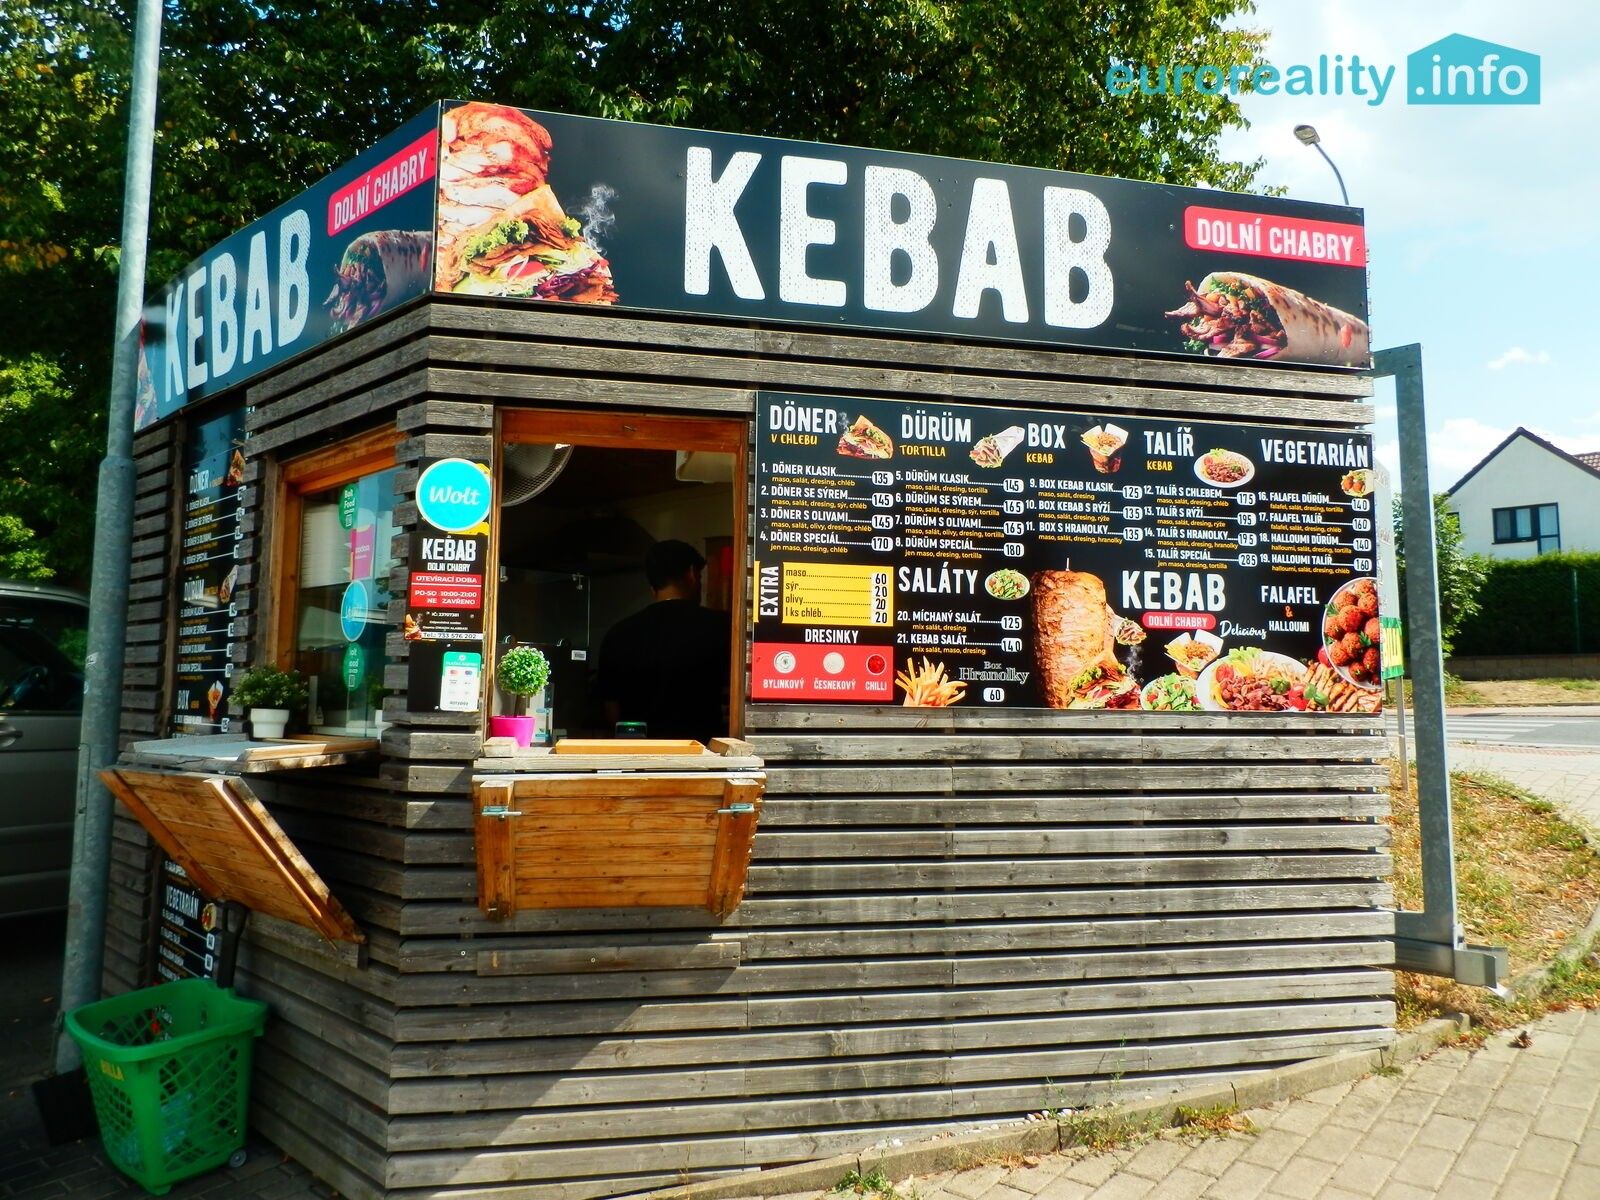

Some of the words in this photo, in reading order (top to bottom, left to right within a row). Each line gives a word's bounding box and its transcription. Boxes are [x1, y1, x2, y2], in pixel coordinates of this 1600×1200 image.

[333, 175, 370, 231] DOLNÍ
[373, 147, 428, 206] CHABRY
[684, 146, 1114, 329] KEBAB
[1196, 217, 1262, 253] DOLNÍ
[1268, 226, 1355, 262] CHABRY
[165, 209, 311, 403] KEBAB
[770, 400, 837, 434] DÖNER
[901, 410, 971, 443] DÜRÜM
[771, 433, 778, 443] V
[780, 434, 818, 445] CHLEBU
[1027, 423, 1066, 449] BOX
[1143, 426, 1194, 457] TALÍŘ
[899, 445, 946, 457] TORTILLA
[1026, 453, 1054, 464] KEBAB
[1260, 438, 1368, 467] VEGETARIÁN
[772, 461, 803, 474] DÖNER
[805, 466, 837, 477] KLASIK
[874, 472, 888, 484] 135
[1146, 460, 1173, 471] KEBAB
[905, 469, 937, 482] DÜRÜM
[939, 473, 969, 484] KLASIK
[1004, 479, 1019, 491] 145
[1038, 479, 1056, 490] BOX
[1057, 480, 1083, 491] KEBAB
[1085, 482, 1114, 493] KLASIK
[1124, 486, 1139, 498] 125
[429, 486, 481, 505] Wolt
[771, 484, 801, 498] DÖNER
[803, 487, 815, 498] SE
[817, 485, 849, 500] SÝREM
[873, 494, 889, 506] 145
[905, 491, 937, 504] DÜRÜM
[939, 495, 950, 505] SE
[952, 493, 982, 506] SÝREM
[1005, 500, 1021, 513] 165
[1143, 485, 1154, 495] 12.
[1155, 484, 1177, 496] TALÍŘ
[1178, 486, 1184, 496] S
[1185, 487, 1222, 498] CHLEBEM
[1239, 493, 1253, 504] 175
[1258, 492, 1268, 501] 16.
[1269, 492, 1300, 503] FALAFEL
[1301, 491, 1330, 503] DÜRÜM
[1353, 499, 1367, 510] 140
[770, 506, 801, 520] DÖNER
[803, 510, 810, 520] S
[811, 510, 848, 522] OLIVAMI
[873, 515, 889, 528] 145
[904, 513, 936, 526] DÜRÜM
[938, 516, 945, 527] S
[946, 517, 981, 529] OLIVAMI
[1005, 522, 1022, 534] 165
[770, 529, 801, 543] DÖNER
[803, 531, 840, 544] SPECIÁL
[873, 537, 888, 550] 170
[1025, 521, 1035, 531] 11.
[1039, 522, 1056, 532] BOX
[1057, 523, 1063, 533] S
[1064, 523, 1108, 535] HRANOLKY
[1125, 528, 1140, 540] 135
[421, 538, 477, 561] KEBAB
[905, 535, 937, 548] DÜRÜM
[939, 538, 973, 550] SPECIÁL
[1005, 544, 1021, 556] 180
[1144, 548, 1155, 558] 15.
[1156, 547, 1178, 559] TALÍŘ
[1180, 549, 1211, 560] SPECIÁL
[1241, 554, 1256, 565] 285
[1260, 554, 1270, 563] 19.
[1271, 554, 1310, 565] HALLOUMI
[1312, 554, 1332, 566] TALÍŘ
[1355, 559, 1369, 571] 160
[446, 563, 471, 573] CHABRY
[785, 569, 807, 577] maso
[875, 573, 887, 585] 60
[898, 561, 979, 595] SALÁTY
[415, 575, 455, 583] OTEVÍRACÍ
[760, 566, 779, 616] EXTRA
[785, 581, 799, 592] sýr
[874, 585, 888, 598] 20
[1122, 570, 1226, 612] KEBAB
[1260, 585, 1320, 605] FALAFEL
[785, 593, 804, 606] olivy
[875, 598, 886, 610] 20
[1284, 605, 1294, 618] &
[789, 606, 799, 617] ks
[801, 607, 822, 618] chléb
[874, 612, 888, 624] 20
[897, 610, 910, 621] 20.
[912, 608, 953, 622] MÍCHANÝ
[954, 610, 981, 623] SALÁT
[1003, 616, 1020, 629] 125
[1148, 613, 1173, 627] DOLNÍ
[1175, 616, 1208, 628] CHABRY
[804, 628, 859, 644] DRESINKY
[1219, 620, 1267, 640] Delicious
[1268, 620, 1310, 632] HALLOUMI
[896, 633, 909, 644] 21.
[910, 633, 939, 645] KEBAB
[940, 632, 967, 645] SALÁT
[1003, 639, 1021, 652] 140
[983, 661, 1002, 669] Box
[763, 677, 805, 689] BYLINKOVÝ
[813, 677, 857, 690] ČESNEKOVÝ
[865, 681, 887, 691] CHILLI
[958, 667, 1030, 684] Hranolky
[989, 689, 1000, 701] 60
